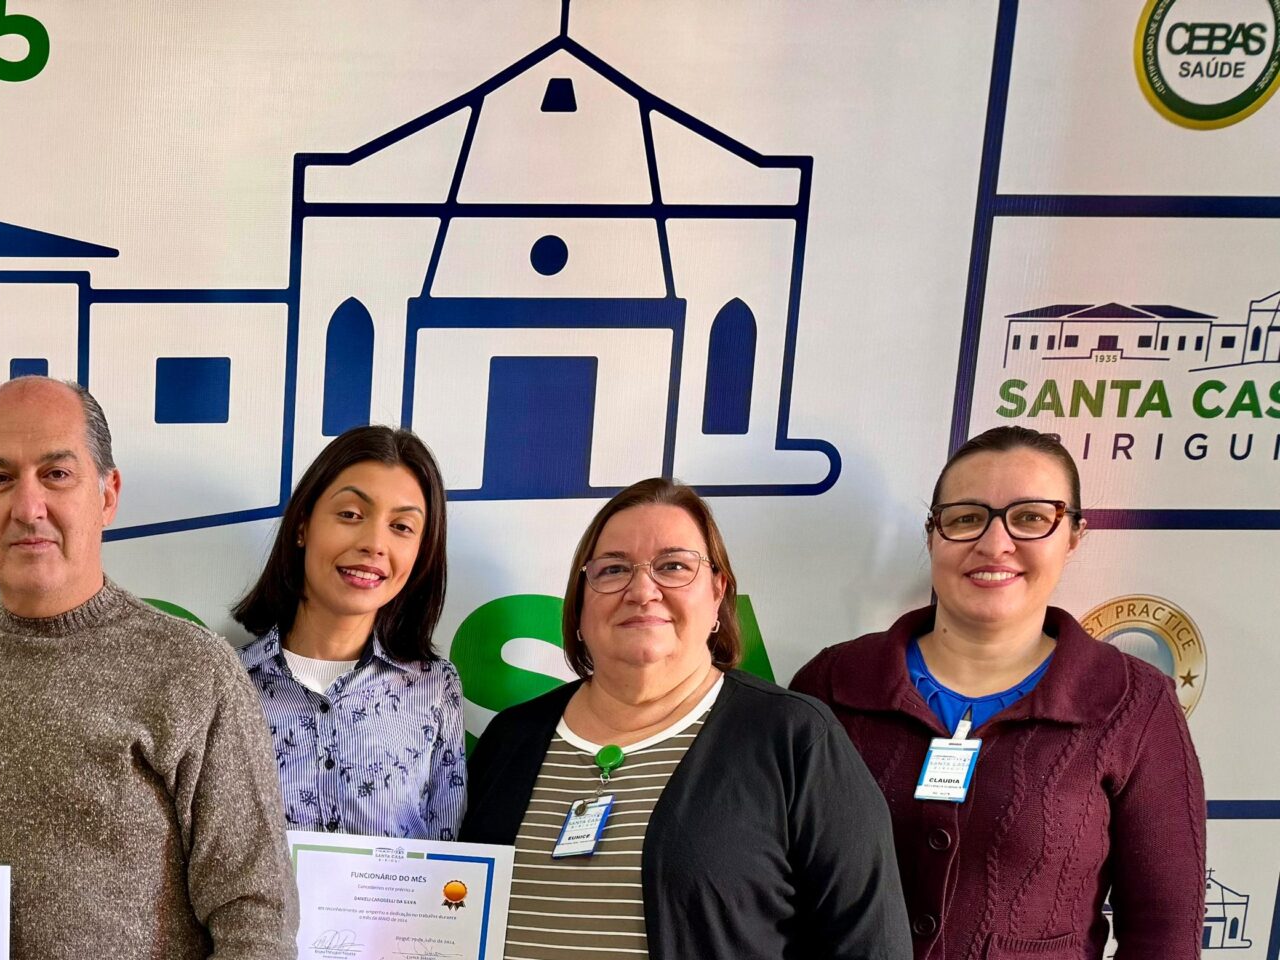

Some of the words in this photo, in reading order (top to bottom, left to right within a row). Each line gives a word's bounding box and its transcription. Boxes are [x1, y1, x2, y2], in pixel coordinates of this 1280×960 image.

[1166, 22, 1267, 56] CEBAS
[1178, 57, 1246, 78] SAÚDE
[1094, 354, 1118, 363] 1935
[996, 379, 1172, 418] SANTA
[1044, 432, 1280, 461] IRIGUI
[1115, 603, 1196, 652] PRACTICE
[351, 872, 397, 881] FUNCIONÁRIO
[411, 875, 427, 883] MÊS
